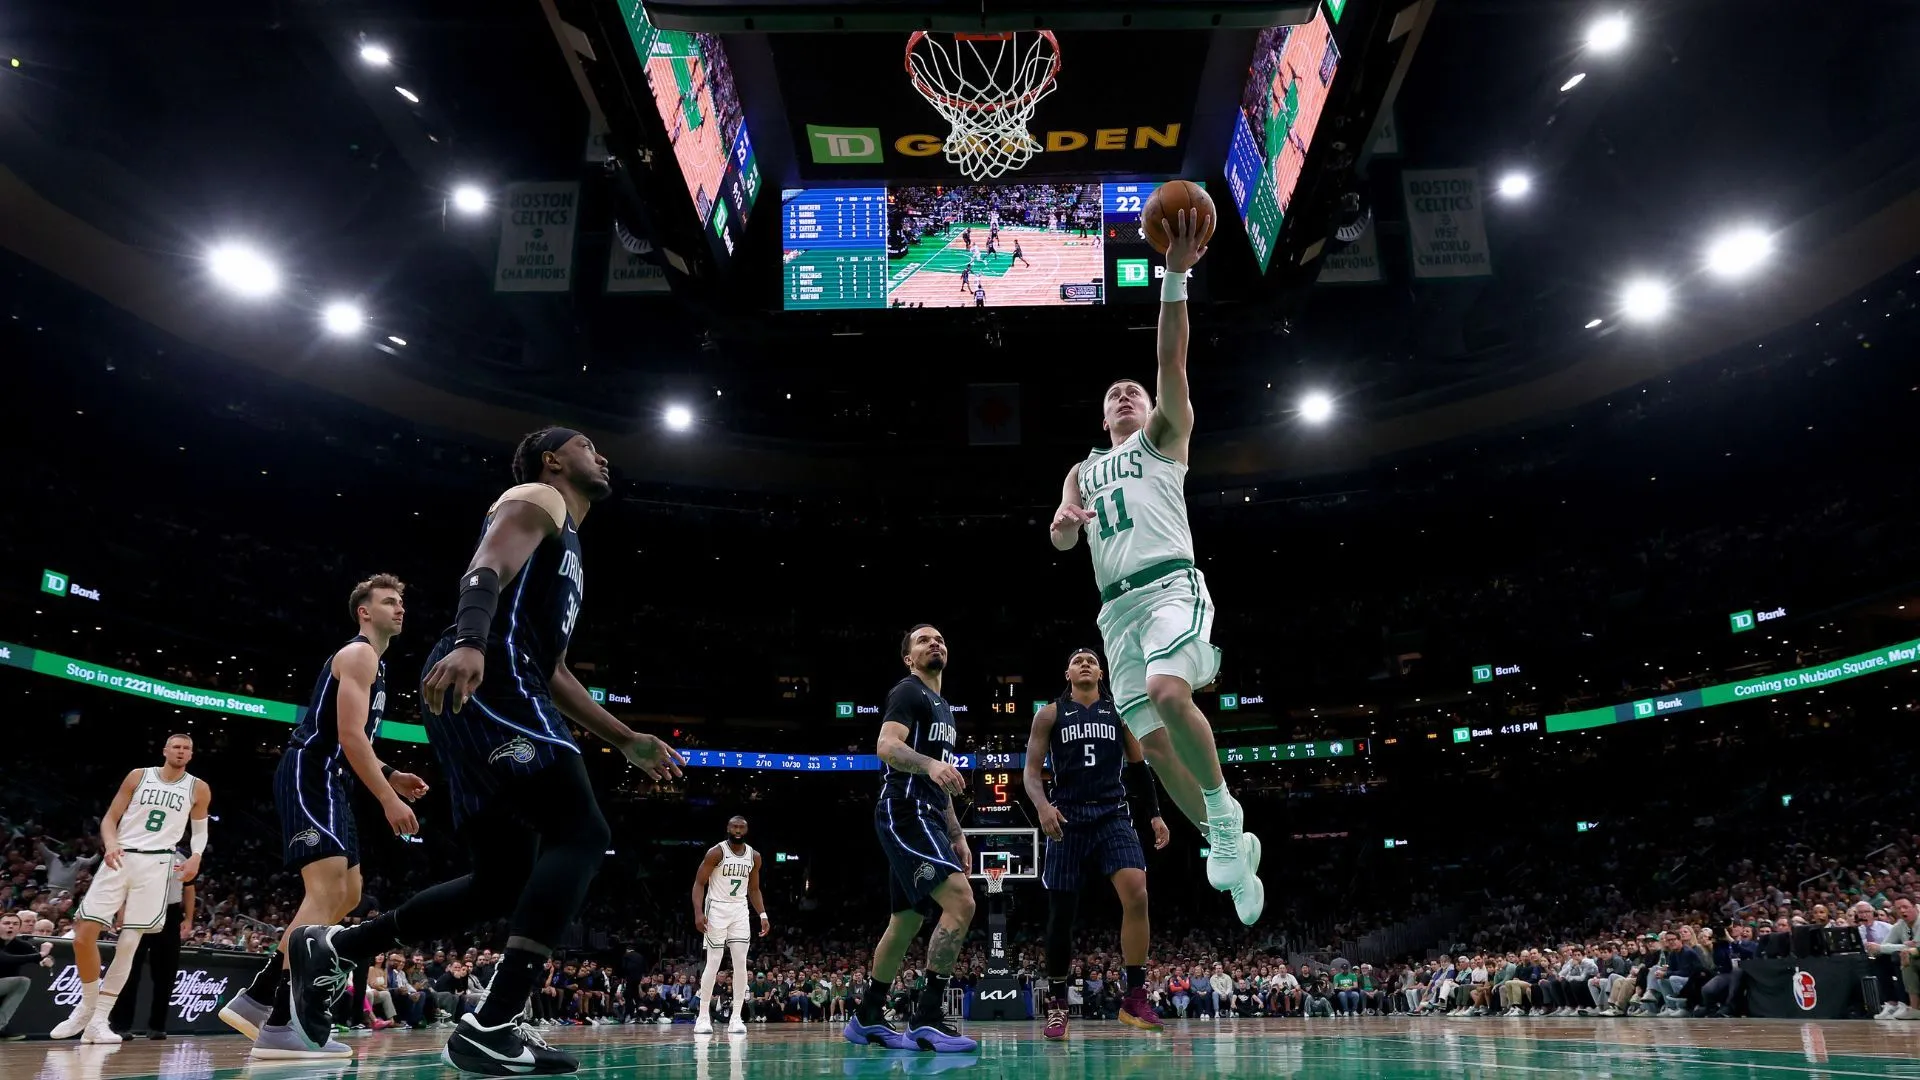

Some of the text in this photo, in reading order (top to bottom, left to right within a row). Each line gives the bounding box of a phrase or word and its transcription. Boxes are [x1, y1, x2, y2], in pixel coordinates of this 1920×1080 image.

[814, 131, 876, 158] TD
[1409, 178, 1474, 196] BOSTON
[510, 191, 573, 208] BOSTON
[1116, 196, 1141, 212] 22
[1414, 196, 1473, 213] CELTICS
[511, 209, 568, 226] CELTICS
[1429, 239, 1471, 253] WORLD
[516, 253, 555, 266] WORLD
[1417, 252, 1486, 266] CHAMPIONS
[501, 267, 566, 280] CHAMPIONS
[612, 267, 664, 281] CHAMPIO
[1119, 264, 1193, 281] TD Bk
[1082, 449, 1144, 496] ELTICS
[1094, 486, 1135, 541] 11
[45, 573, 101, 601] TD Bank
[1732, 607, 1787, 629] TD Bank
[1473, 664, 1521, 680] TD Bank
[1734, 646, 1917, 698] Coming to Nubian Square, May
[66, 662, 267, 715] Stop in at 2221 Washington Street.
[589, 689, 632, 704] TD Bank
[837, 704, 879, 715] TD Bank
[949, 704, 968, 713] Bank
[992, 702, 1015, 714] 4:18
[1221, 695, 1264, 707] TD Bank
[1637, 697, 1683, 716] TD Bank
[1061, 722, 1116, 744] ORLANDO
[1454, 721, 1539, 740] TD Bank 4:18 PM
[953, 754, 1010, 768] 22 9:13
[1084, 743, 1096, 767] 5
[1227, 743, 1364, 762] 5/10 3 4 6 13 5
[702, 757, 707, 765] 5
[756, 760, 772, 768] 2/10
[782, 761, 801, 769] 10/30
[807, 761, 820, 769] 33.3
[984, 773, 1009, 785] 9:13
[139, 787, 185, 812] CELTICS
[995, 784, 1007, 803] 5
[987, 805, 1012, 813] TISSOT
[145, 808, 167, 832] 8
[722, 863, 752, 879] CELTICS
[729, 879, 742, 897] 7
[992, 932, 1003, 941] GET
[992, 940, 1003, 949] THE
[987, 967, 1009, 977] Google
[171, 969, 229, 996] Different
[169, 993, 218, 1023] Here
